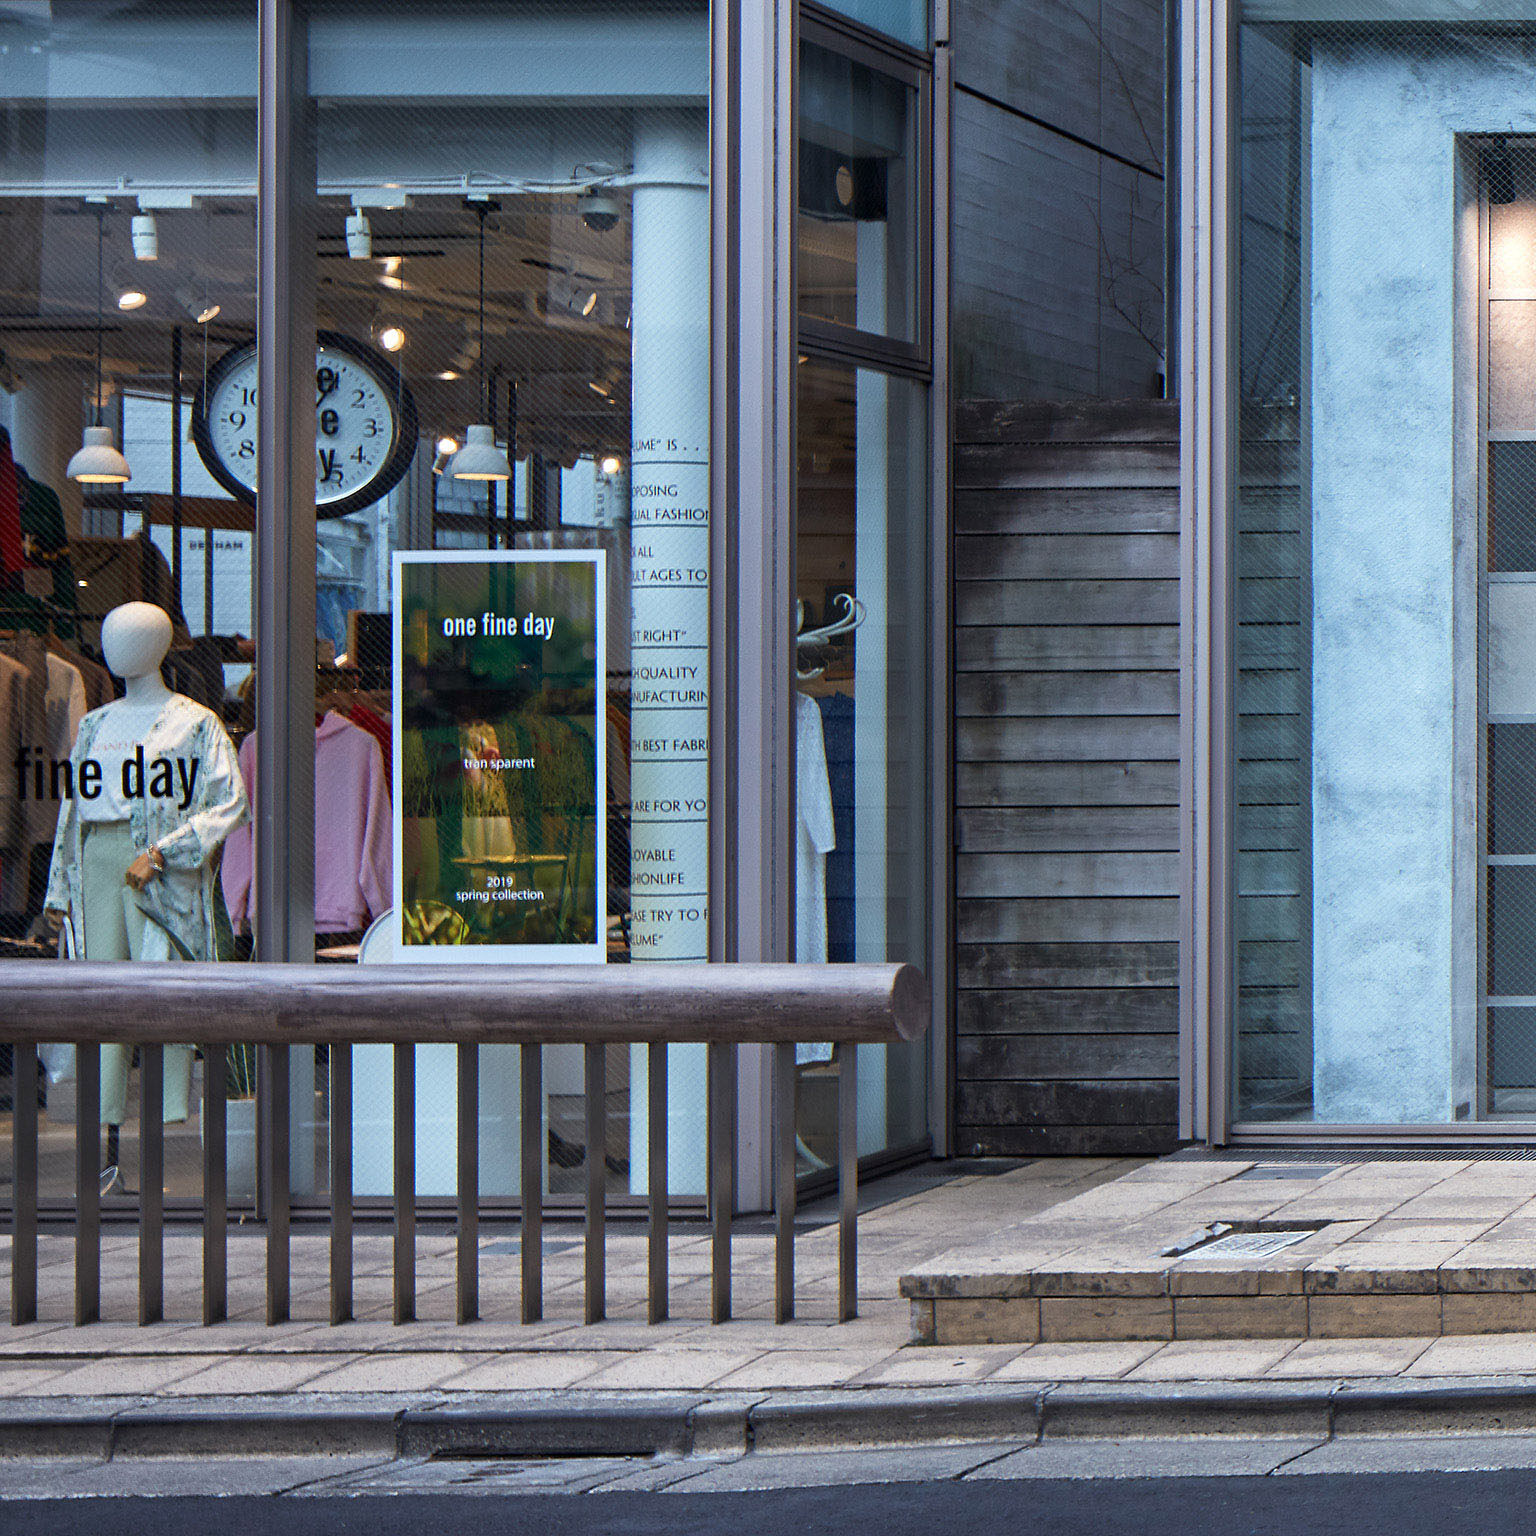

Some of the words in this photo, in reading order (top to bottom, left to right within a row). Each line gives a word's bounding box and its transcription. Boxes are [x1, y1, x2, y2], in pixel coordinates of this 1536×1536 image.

[351, 389, 366, 409] 2
[229, 410, 246, 433] 9
[363, 418, 378, 438] 3
[238, 439, 255, 460] 8
[667, 438, 677, 451] IS
[350, 445, 367, 464] 4
[650, 569, 682, 582] AGES
[687, 569, 708, 582] TO
[443, 617, 477, 637] one
[482, 612, 518, 637] fine
[523, 612, 555, 640] day
[643, 739, 668, 752] BEST
[14, 746, 102, 801] fine
[121, 745, 201, 809] day
[653, 799, 681, 812] FOR
[486, 876, 513, 888] 2019
[456, 889, 490, 903] spring
[492, 888, 544, 901] collection
[650, 909, 674, 922] TRY
[678, 908, 699, 921] TO
